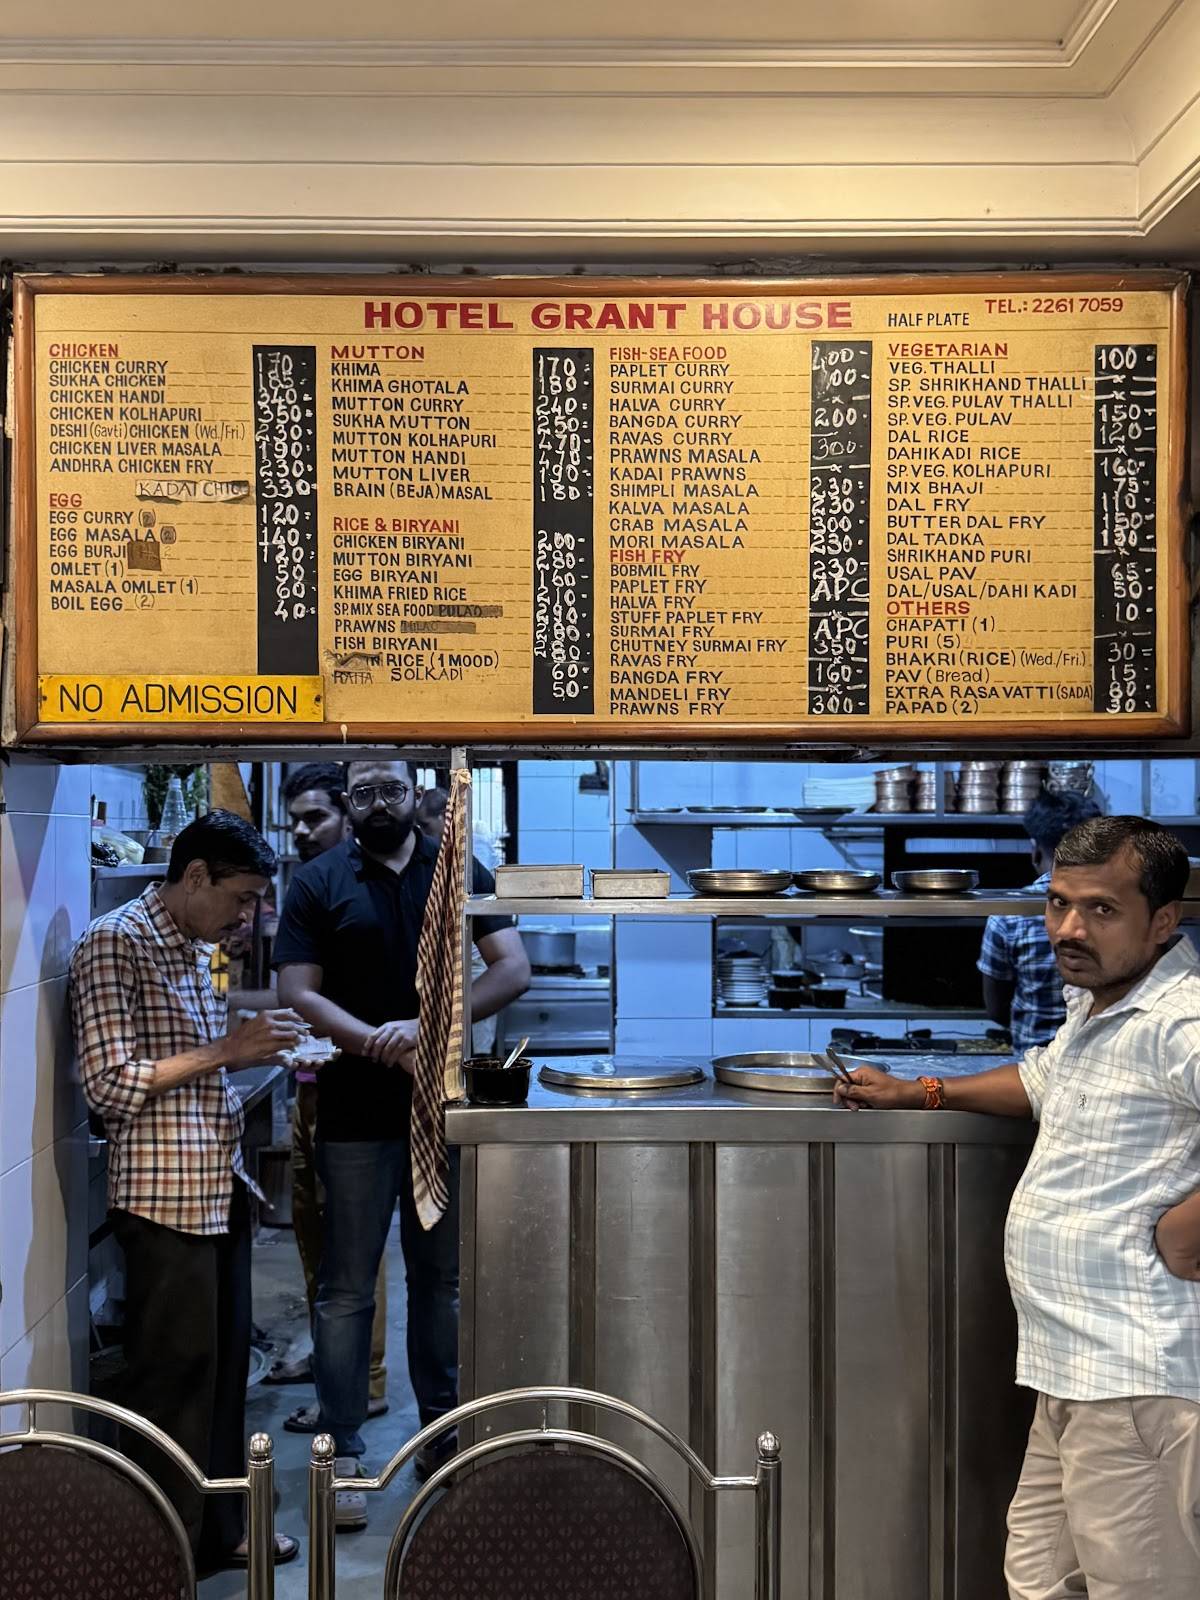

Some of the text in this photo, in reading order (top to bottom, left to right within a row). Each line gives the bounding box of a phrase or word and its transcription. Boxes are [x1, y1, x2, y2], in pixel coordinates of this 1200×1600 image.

[364, 302, 852, 329] HOTEL GRANT HOUSE
[888, 313, 969, 326] HALF PLATE
[49, 344, 118, 357] CHICKEN
[331, 346, 424, 359] MUTTON
[684, 347, 726, 359] FOOD
[889, 343, 1008, 357] VEGETARIAN
[50, 361, 168, 373] CHICKEN CURRY
[331, 363, 380, 376] KHIMA
[610, 364, 730, 377] PAPLET CURRY
[890, 361, 994, 373] VEG. THALLI
[49, 375, 166, 386] SUKHA CHICKEN
[331, 379, 469, 394] KHIMA GHOTALA
[611, 381, 733, 393] SURMAI CURRY
[920, 377, 1086, 390] SHRIKHAND THALLI
[50, 391, 164, 403] CHICKEN HANDI
[952, 395, 1072, 408] PULAV THALLI
[332, 398, 464, 412] MUTTON CURRY
[50, 408, 202, 421] CHICKEN KOLHAPURI
[610, 415, 742, 427] BANGDA CURRY
[956, 412, 1012, 425] PULAV
[333, 415, 469, 429] SUKHA MUTTON
[409, 433, 496, 447] KOLHAPURI
[888, 430, 968, 442] DAL RICE
[50, 442, 221, 456] CHICKEN LIVER MASALA
[888, 447, 1020, 459] DAHIKADI RICE
[412, 451, 465, 464] HANDI
[610, 450, 761, 463] PRAWNS MASALA
[50, 459, 213, 473] ANDHRA CHICKEN FRY
[953, 464, 1050, 478] KOLHAPURI
[334, 467, 470, 481] MUTTON LIVER
[610, 468, 746, 480] KADAI PRAWNS
[334, 483, 384, 497] BRAIN
[610, 484, 759, 497] SHIMPLI MASALA
[888, 482, 983, 493] MIX BHAJI
[49, 494, 82, 507] EGG
[888, 499, 970, 511] DAL FRY
[84, 512, 134, 524] CURRY
[610, 518, 748, 531] CRAB MASALA
[888, 516, 1046, 528] BUTTER DAL FRY
[334, 517, 459, 533] RICE & BIRYANI
[50, 530, 157, 542] EGG MASALA
[888, 533, 984, 545] DAL TADKA
[334, 536, 464, 550] CHICKEN BIRYANI
[50, 546, 126, 558] EGG BURJI
[610, 551, 685, 562] FISH FRY
[888, 550, 1030, 562] SHRIKHAND PURI
[334, 553, 472, 567] MUTTON BIRYANI
[51, 563, 124, 577] OMLET (1)
[334, 570, 438, 583] EGG BIRYANI
[611, 565, 700, 576] BOBMIL FRY
[888, 567, 976, 580] USAL PAV
[51, 580, 177, 593] MASALA OMLET
[334, 586, 466, 600] KHIMA FRIED RICE
[611, 580, 706, 593] PAPLET FRY
[52, 595, 154, 610] BOIL EGG (2)
[887, 601, 970, 615] OTHERS
[377, 604, 434, 617] SEA FOOD
[611, 611, 763, 623] STUFF PAPLET FRY
[335, 620, 395, 632] PRAWNS
[887, 616, 995, 633] CHAPATI (1)
[335, 637, 437, 650] FISH BIRYANI
[610, 640, 787, 651] CHUTNEY SURMAI FRY
[887, 634, 961, 649] PURI (5)
[387, 654, 424, 666] RICE
[887, 652, 956, 665] BHAKRI
[959, 650, 1016, 666] (RICE)
[391, 669, 463, 680] SOLKADI
[611, 671, 723, 684] BANGDA FRY
[886, 667, 989, 683] PAV (Bread)
[611, 688, 731, 700] MANDELI FRY
[886, 686, 944, 697] EXTRA
[60, 684, 296, 714] NO ADMISSION
[610, 703, 724, 714] PRAWNS FRY
[886, 700, 979, 714] PAPAD (2)
